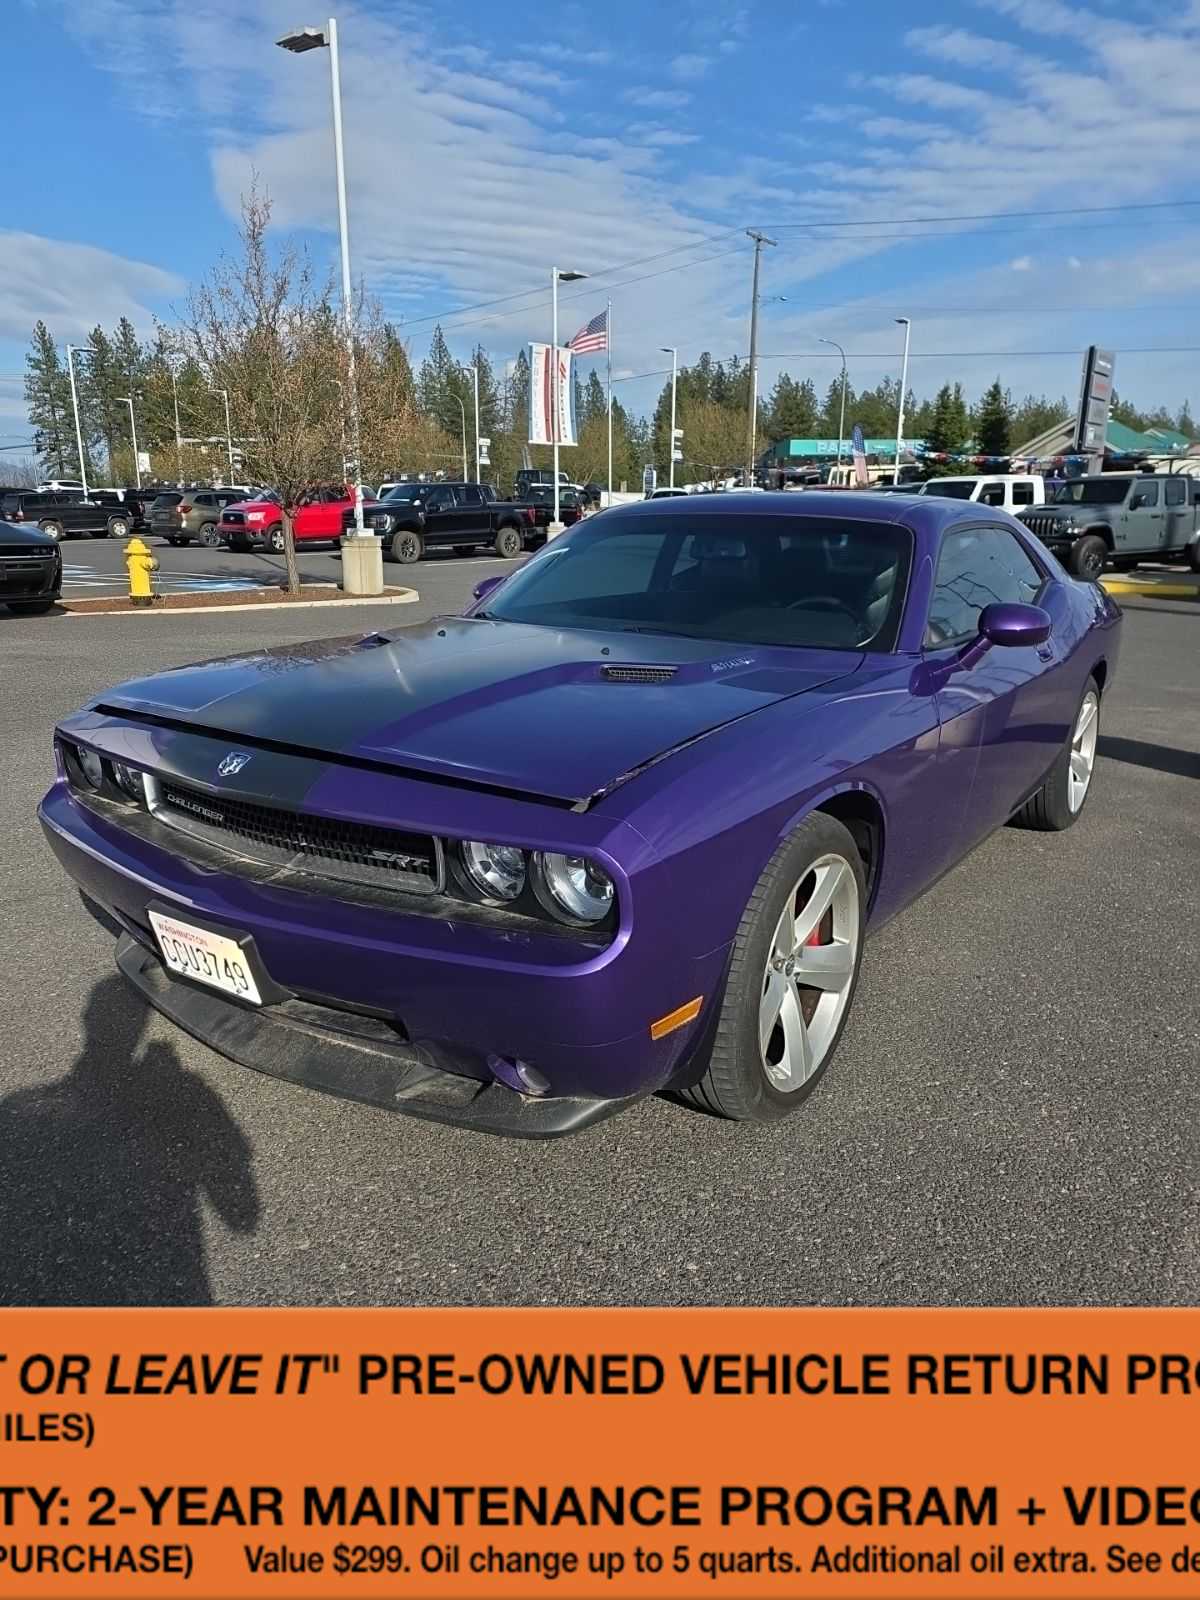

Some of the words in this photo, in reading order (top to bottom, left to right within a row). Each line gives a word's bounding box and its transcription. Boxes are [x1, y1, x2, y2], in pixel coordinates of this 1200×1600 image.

[167, 793, 224, 821] CHALLENGER
[158, 922, 209, 946] WASHINGTON
[161, 934, 249, 990] CCU3749
